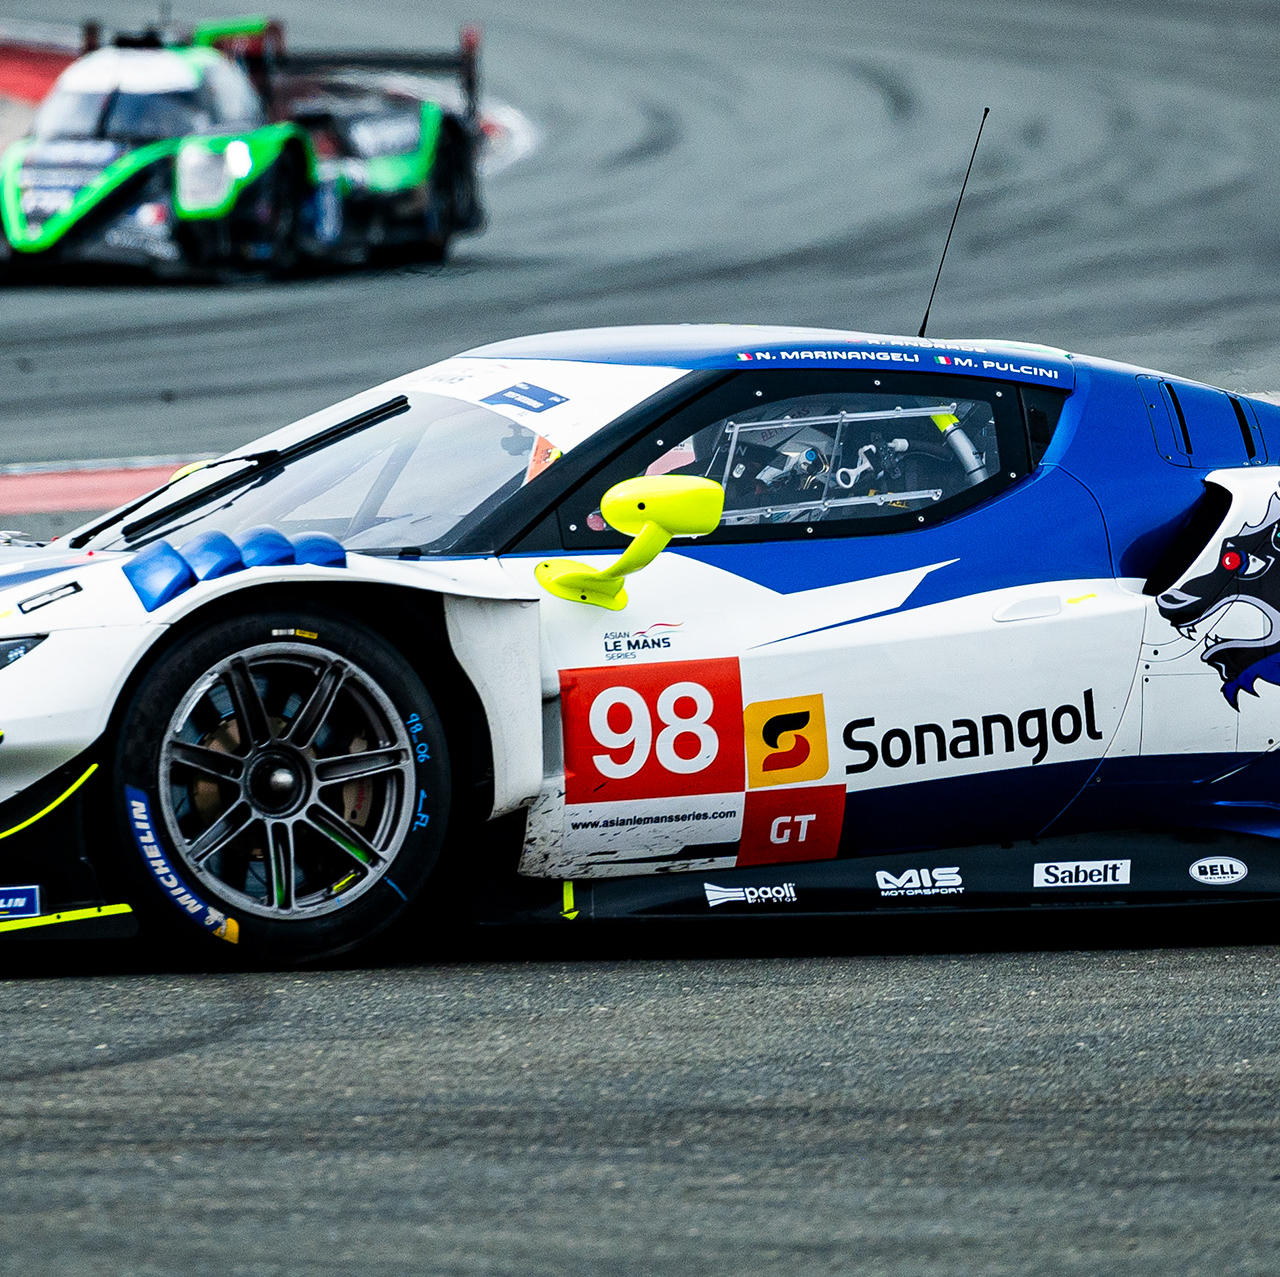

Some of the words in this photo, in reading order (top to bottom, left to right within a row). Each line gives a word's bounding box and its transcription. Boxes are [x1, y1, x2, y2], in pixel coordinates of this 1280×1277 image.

[756, 351, 776, 360] N.
[779, 350, 919, 363] MARINANGELI
[953, 356, 977, 368] M.
[982, 360, 1058, 379] PULCINI
[604, 631, 630, 640] ASIAN
[604, 640, 622, 652] LE
[627, 637, 671, 651] MANS
[605, 651, 637, 661] SERIES
[588, 681, 719, 779] 98
[842, 687, 1103, 775] Sonangol
[571, 808, 737, 830] www.asianlemansseries.com
[770, 813, 817, 844] GT
[130, 800, 203, 914] MICHELIN
[875, 866, 962, 889] MIS
[1043, 863, 1121, 884] Sabelt
[1197, 863, 1239, 876] BELL
[744, 882, 794, 903] paoli
[881, 887, 965, 896] MOTORSPORT
